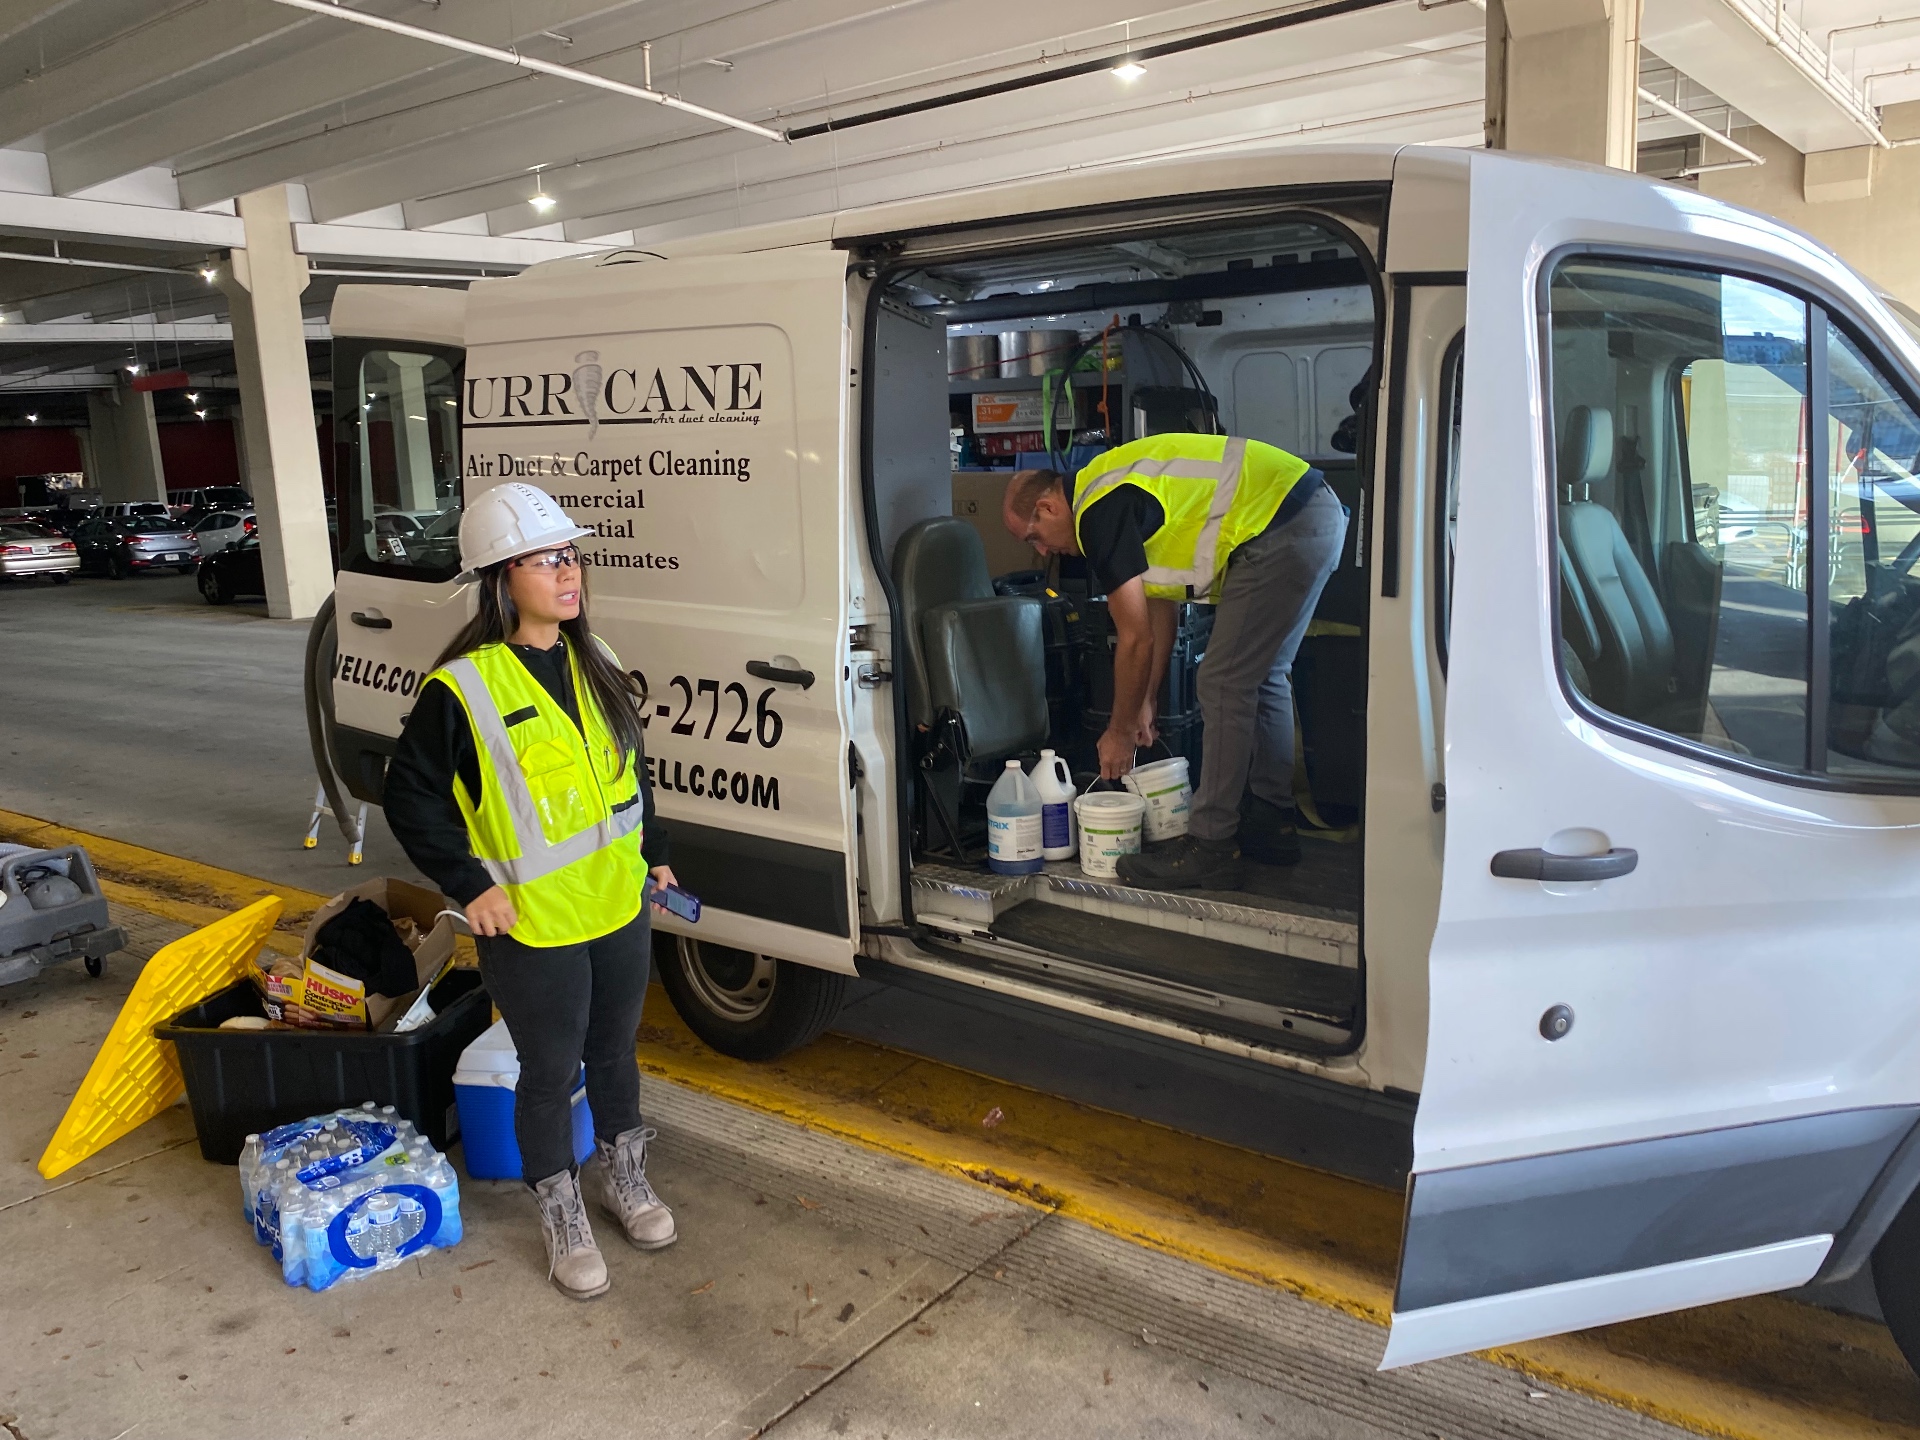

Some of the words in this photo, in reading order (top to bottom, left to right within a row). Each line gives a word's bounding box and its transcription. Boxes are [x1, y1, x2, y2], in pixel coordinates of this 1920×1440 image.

[653, 412, 675, 425] Air
[678, 413, 705, 424] duct
[708, 411, 761, 426] cleaning
[466, 453, 494, 477] Air
[497, 453, 544, 477] Duct
[550, 451, 567, 477] &
[573, 451, 643, 482] Carpet
[648, 449, 751, 483] Cleaning
[575, 518, 635, 539] ntial
[339, 653, 426, 699] ELLC.CO
[305, 989, 352, 1010] Contractor
[306, 976, 361, 1006] HUSKY
[304, 994, 344, 1012] Clean-Up
